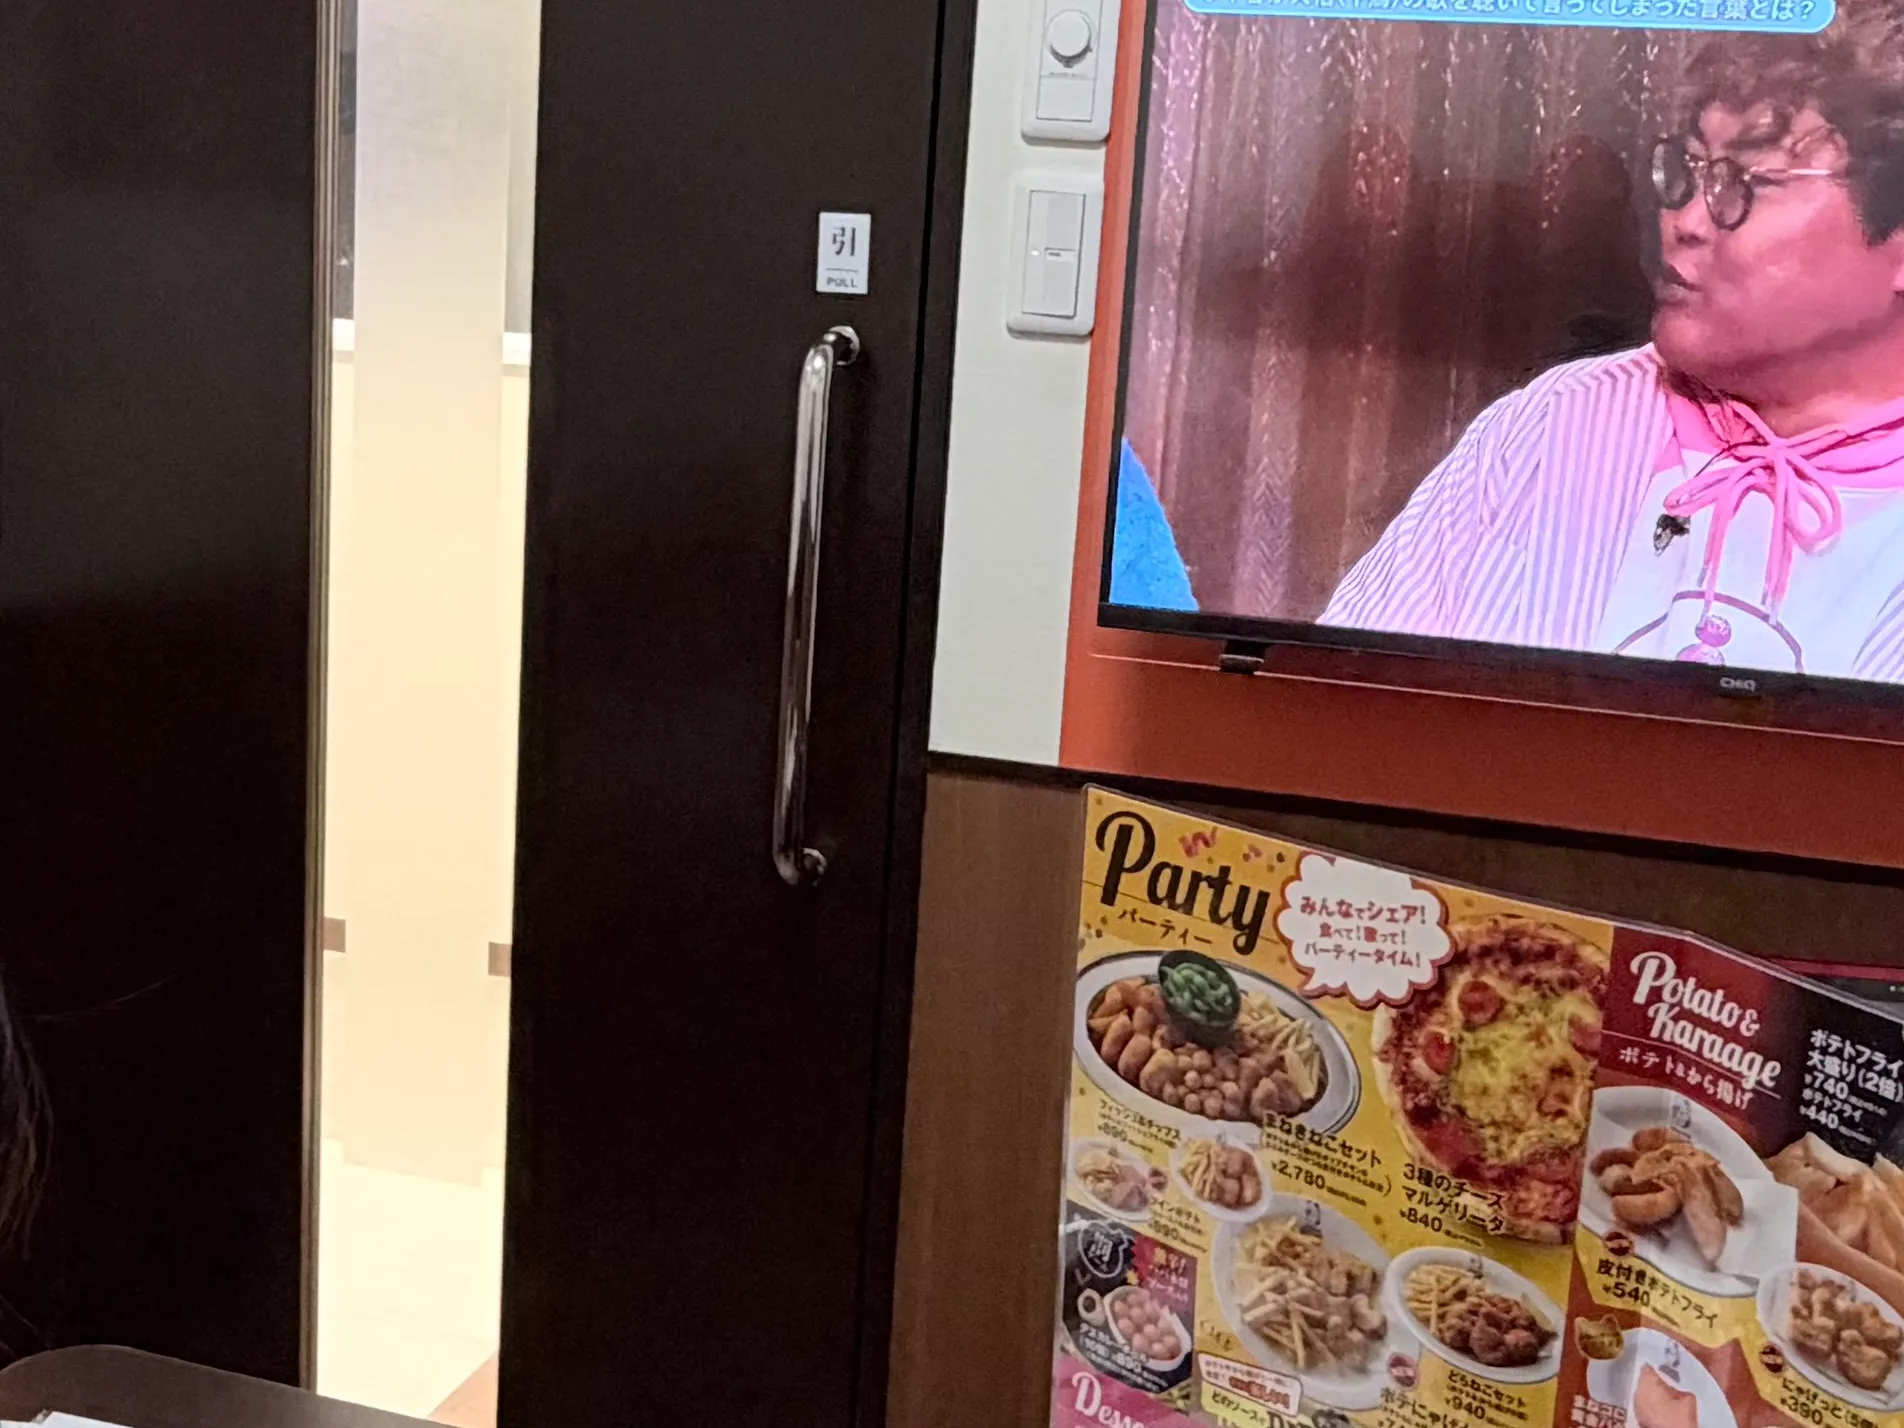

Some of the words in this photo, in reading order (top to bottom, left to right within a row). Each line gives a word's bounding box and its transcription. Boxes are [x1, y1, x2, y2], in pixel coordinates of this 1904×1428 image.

[832, 225, 857, 257] 引
[826, 276, 859, 289] PULL
[1096, 811, 1271, 956] Party
[1299, 895, 1427, 925] みんなでシェア!
[1118, 907, 1214, 946] パーティー
[1304, 940, 1421, 968] パーティータイム!
[1630, 950, 1739, 1028] Potato
[1739, 1008, 1761, 1037] &
[1647, 1000, 1783, 1090] Karaage
[1809, 1028, 1904, 1079] ポテトフライ
[1618, 1046, 1756, 1112] ポテト&から揚げ
[1804, 1070, 1849, 1101] ¥740
[1799, 1105, 1839, 1129] ¥440
[1271, 1157, 1327, 1191] ¥2,780
[1399, 1206, 1445, 1234] ¥840
[1400, 1184, 1506, 1235] マルゲリータ
[1601, 1281, 1651, 1308] ¥540
[1443, 1392, 1487, 1422] ¥940
[1779, 1395, 1824, 1425] ¥390
